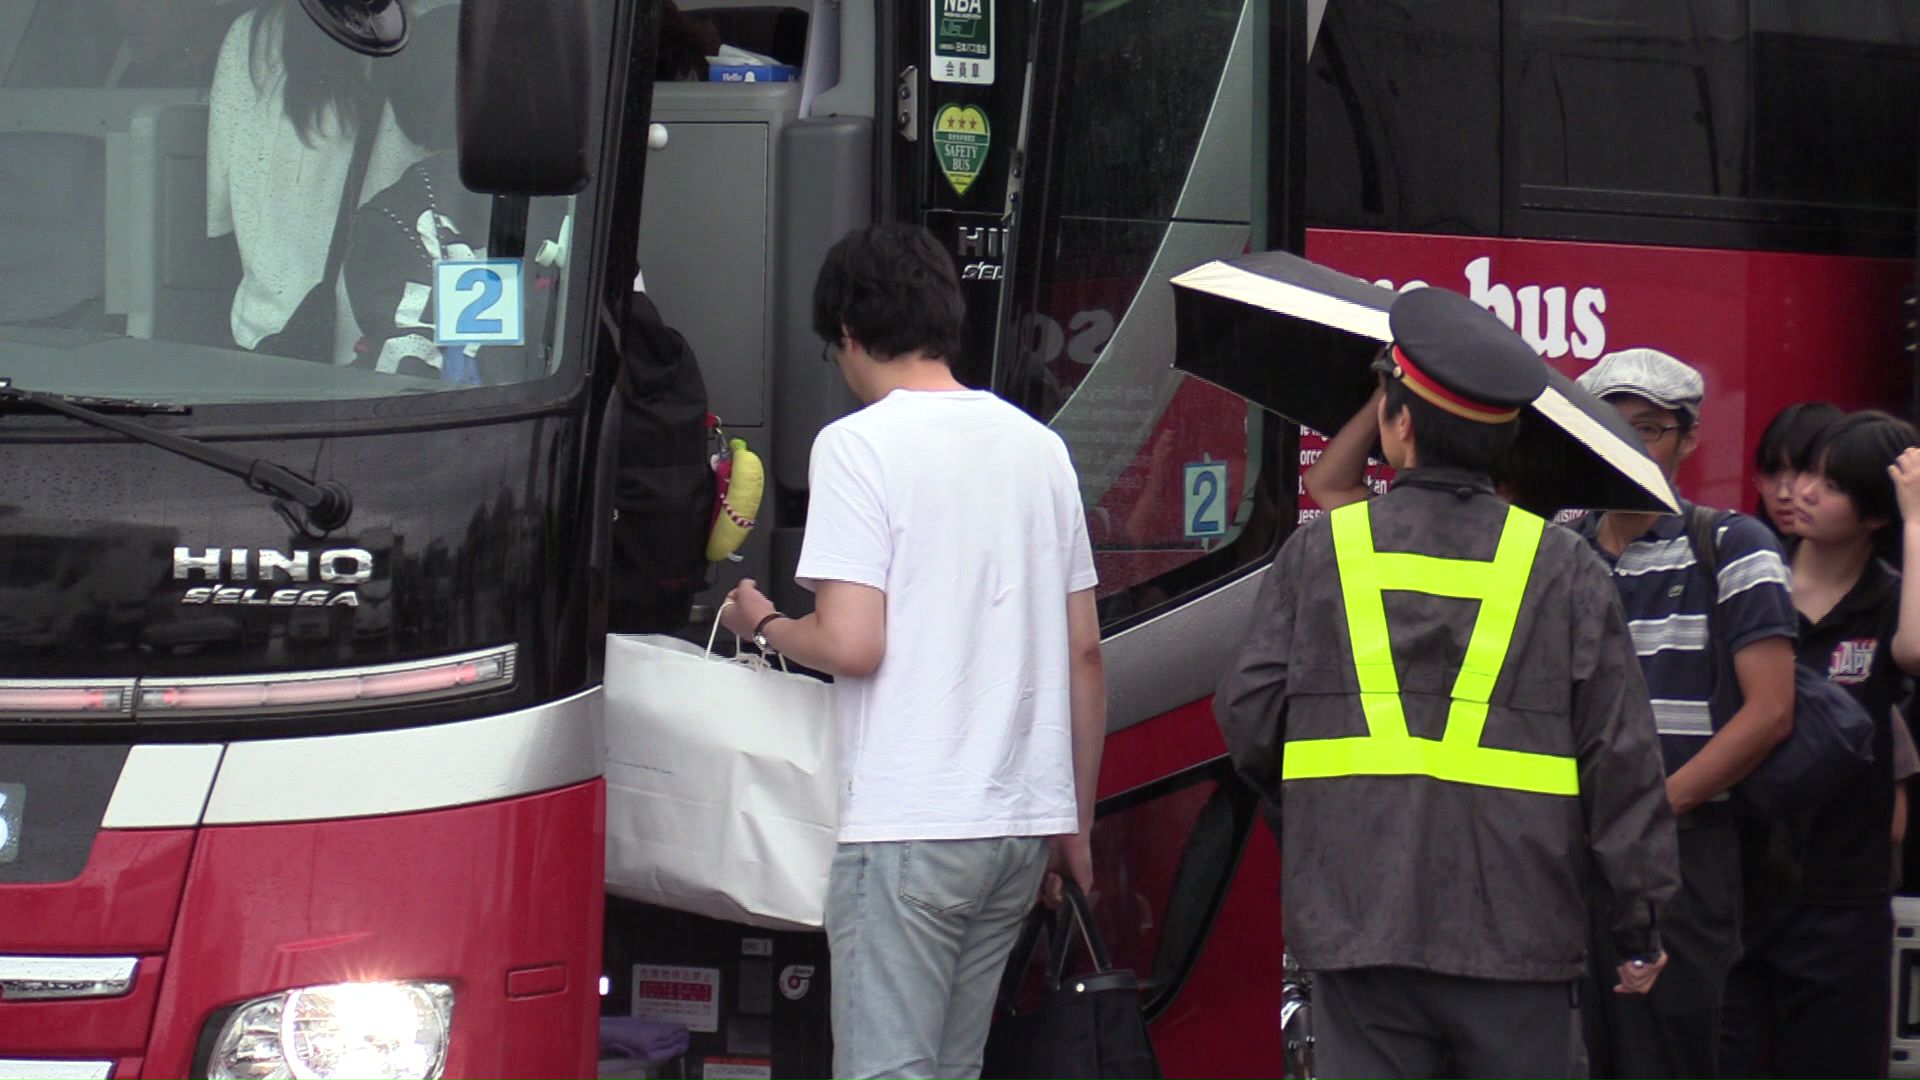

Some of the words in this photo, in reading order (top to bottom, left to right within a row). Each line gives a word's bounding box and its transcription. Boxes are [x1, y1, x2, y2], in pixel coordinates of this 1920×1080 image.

[943, 0, 982, 13] NBA
[944, 143, 978, 159] SAFETY
[952, 158, 970, 171] BUS
[456, 268, 503, 334] 2
[1464, 257, 1606, 360] bus
[1192, 471, 1219, 533] 2
[173, 547, 373, 584] HINO
